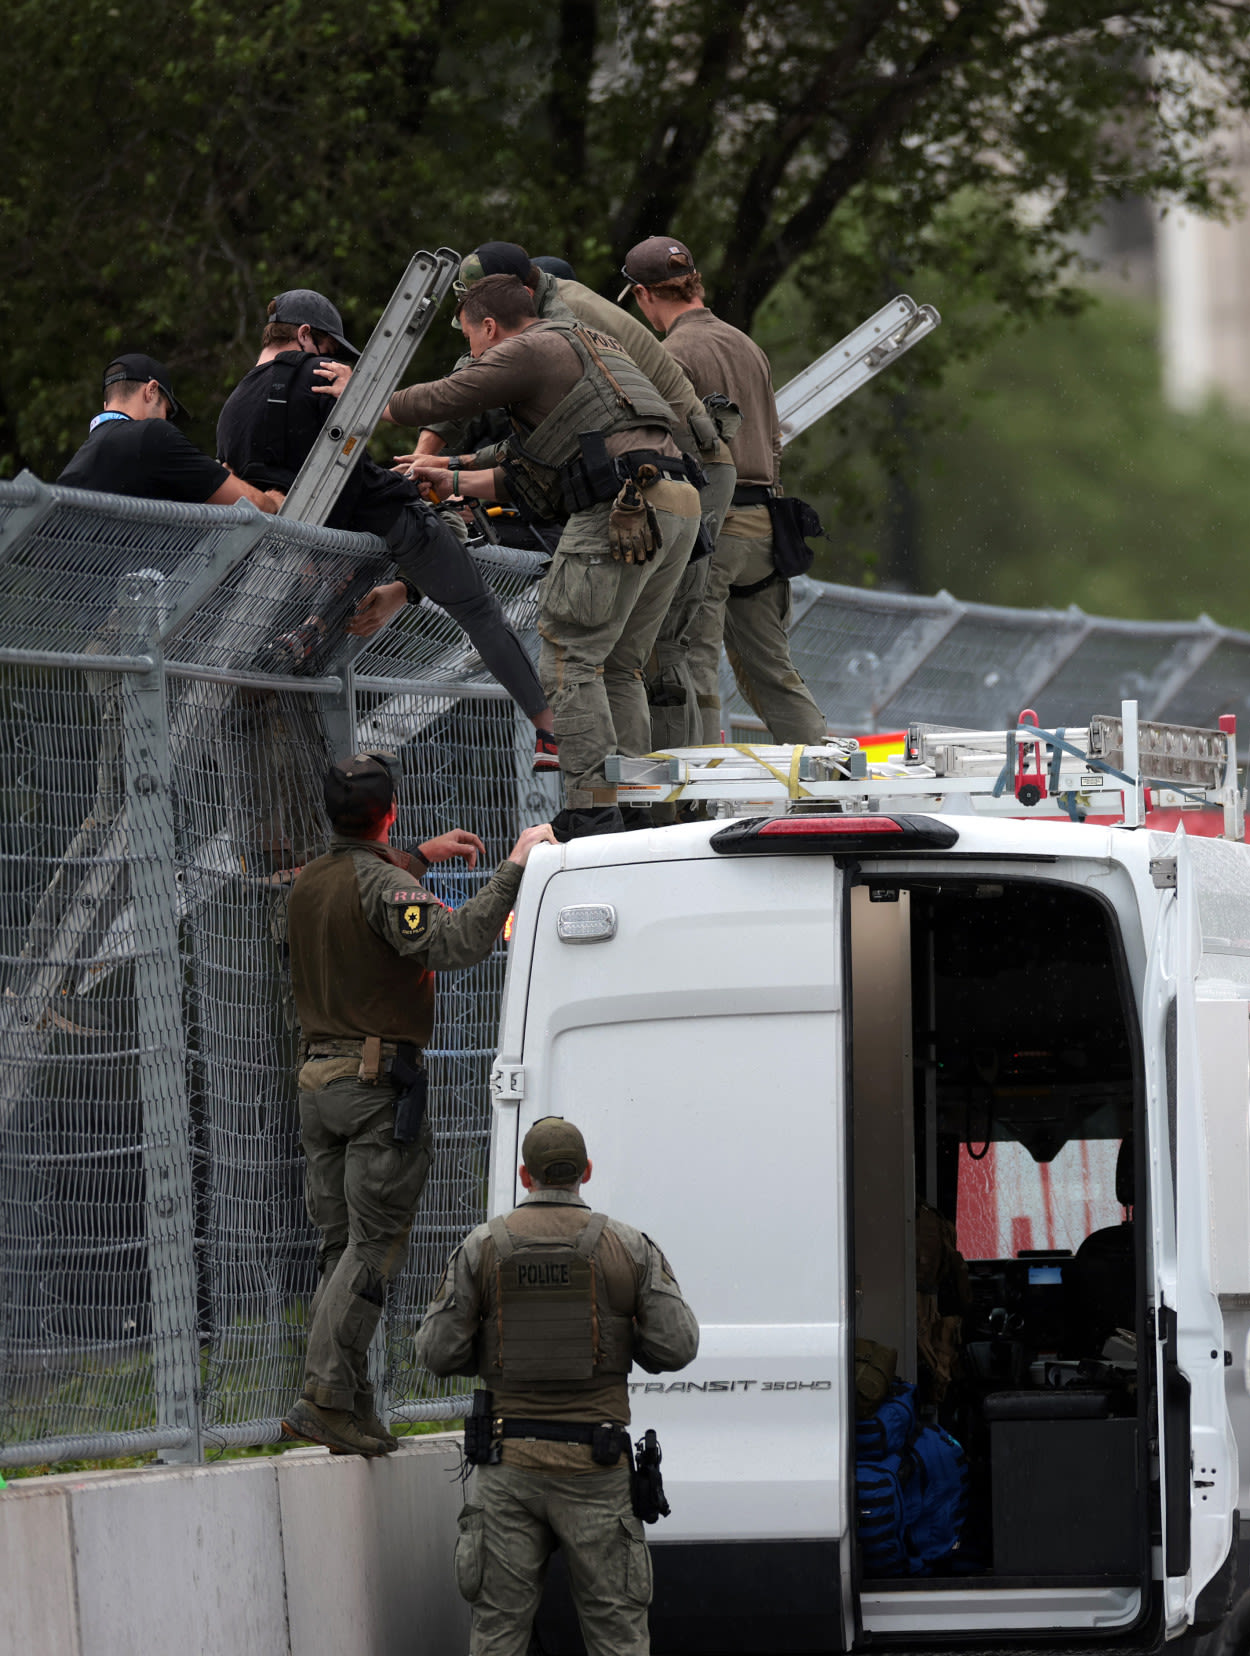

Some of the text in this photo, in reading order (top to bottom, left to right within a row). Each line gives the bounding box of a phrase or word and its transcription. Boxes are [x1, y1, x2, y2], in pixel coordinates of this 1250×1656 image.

[518, 1264, 569, 1284] POLICE
[628, 1380, 832, 1394] TRANSIT 350HD
